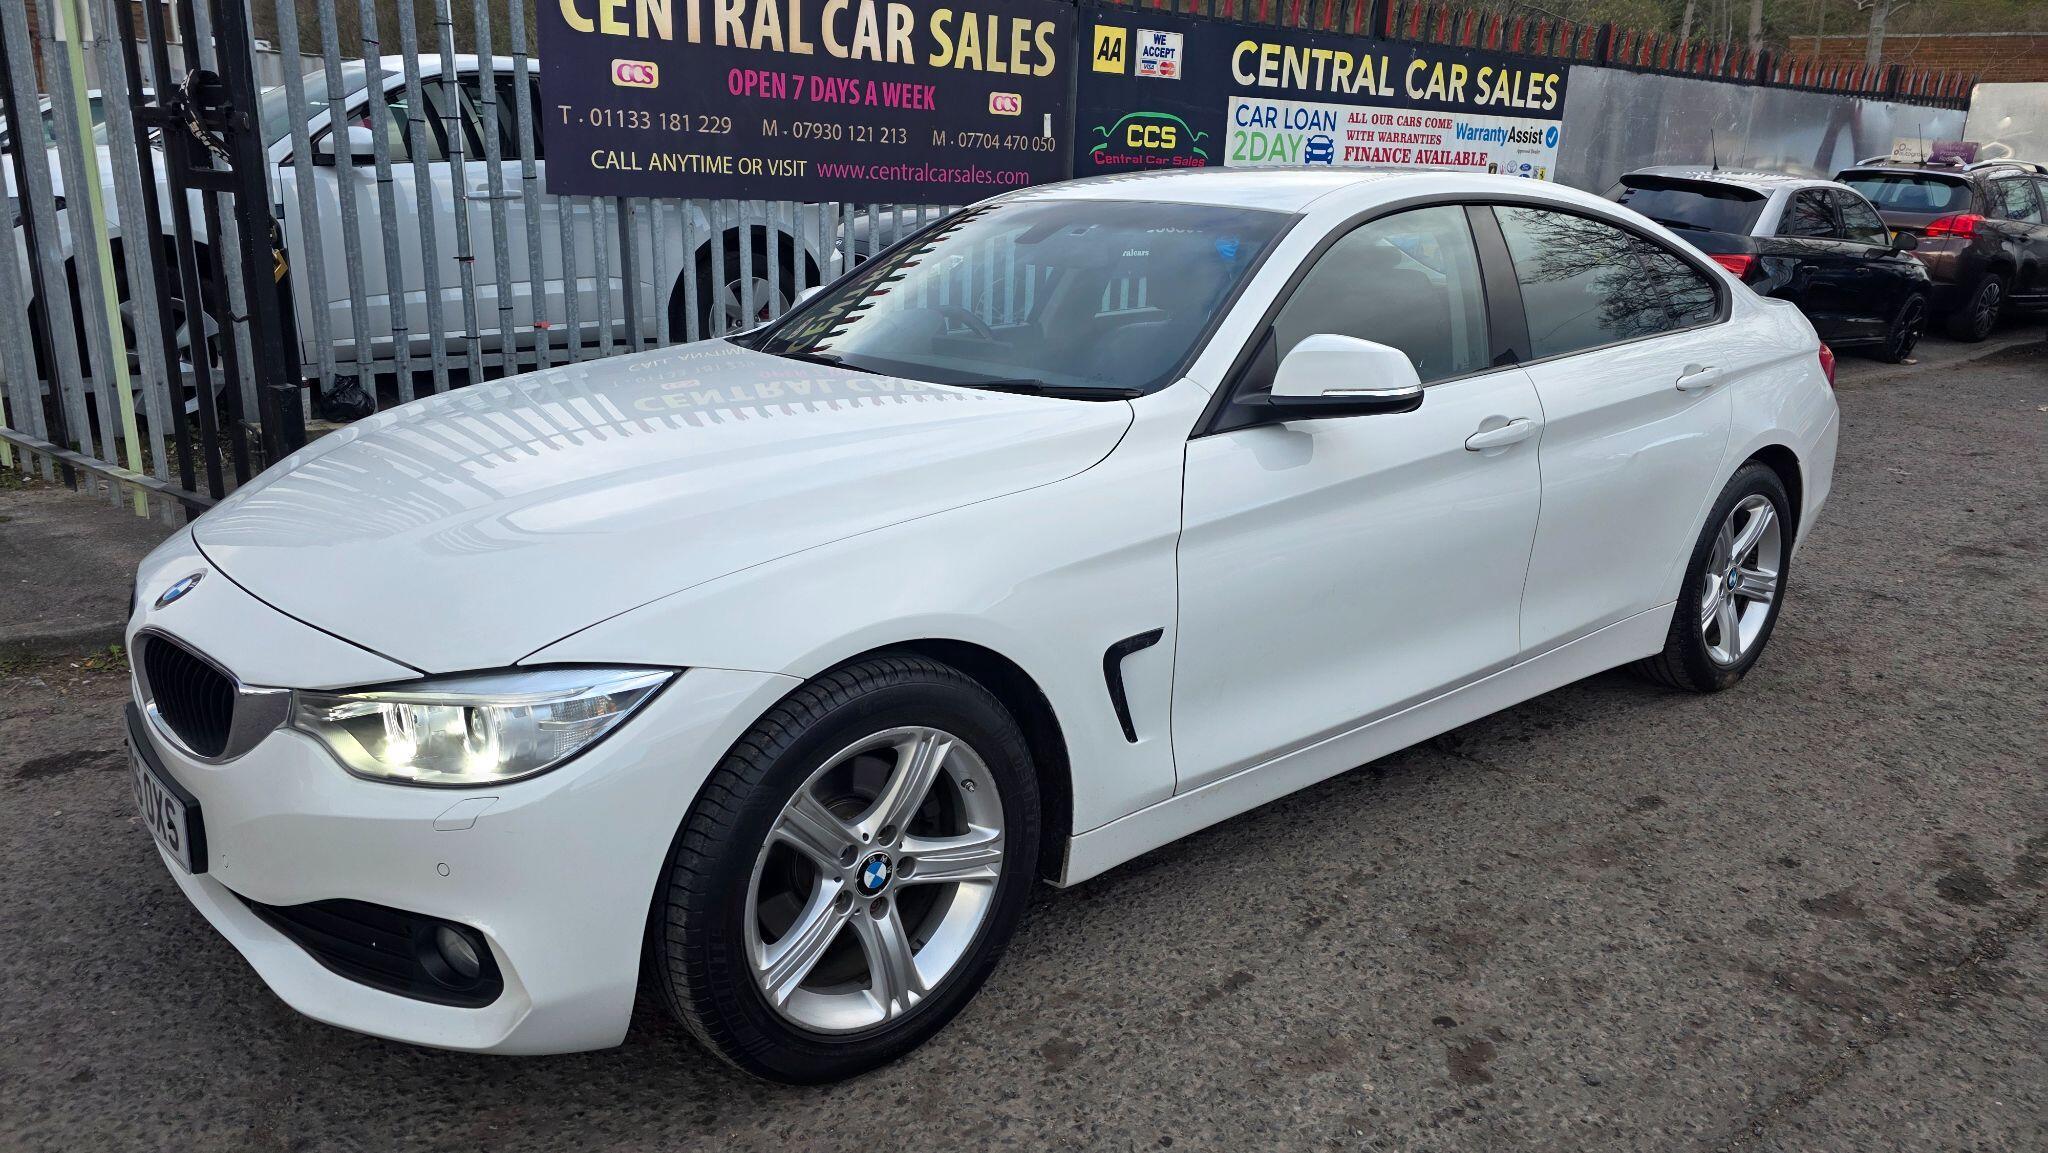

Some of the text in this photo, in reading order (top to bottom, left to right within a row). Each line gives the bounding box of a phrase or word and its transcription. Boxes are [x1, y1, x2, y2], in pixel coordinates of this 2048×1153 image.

[821, 0, 915, 65] CAR
[929, 8, 1056, 77] SALES
[1097, 36, 1122, 62] AA
[1153, 33, 1167, 45] WE
[1142, 46, 1176, 59] ACCEPT
[616, 63, 654, 85] CCS
[1231, 40, 1559, 111] CENTRAL CAR SALES
[728, 68, 936, 110] OPEN 7 DAYS A WEEK
[992, 95, 1018, 112] CCS
[590, 108, 651, 130] 01133
[660, 112, 690, 132] 181
[698, 115, 732, 134] 229
[1235, 104, 1337, 132] CAR LOAN
[1347, 112, 1453, 130] ALL OUR CARS COME
[792, 121, 842, 140] 07930
[848, 125, 873, 143] 121
[880, 127, 907, 144] 213
[958, 132, 1000, 149] 07704
[1003, 135, 1028, 151] 470
[1032, 137, 1056, 152] 050
[1126, 124, 1177, 149] CCS
[1346, 130, 1442, 146] WITH WARRANTIES
[1456, 122, 1543, 146] WarrantyAssist
[1232, 130, 1304, 163] 2DAY
[1344, 146, 1412, 164] FINANCE
[1414, 149, 1488, 167] AVAILABLE
[591, 150, 1030, 186] CALL ANYTIME OR VISIT www.centralcarsales.com
[1094, 150, 1205, 167] Central Car Sales
